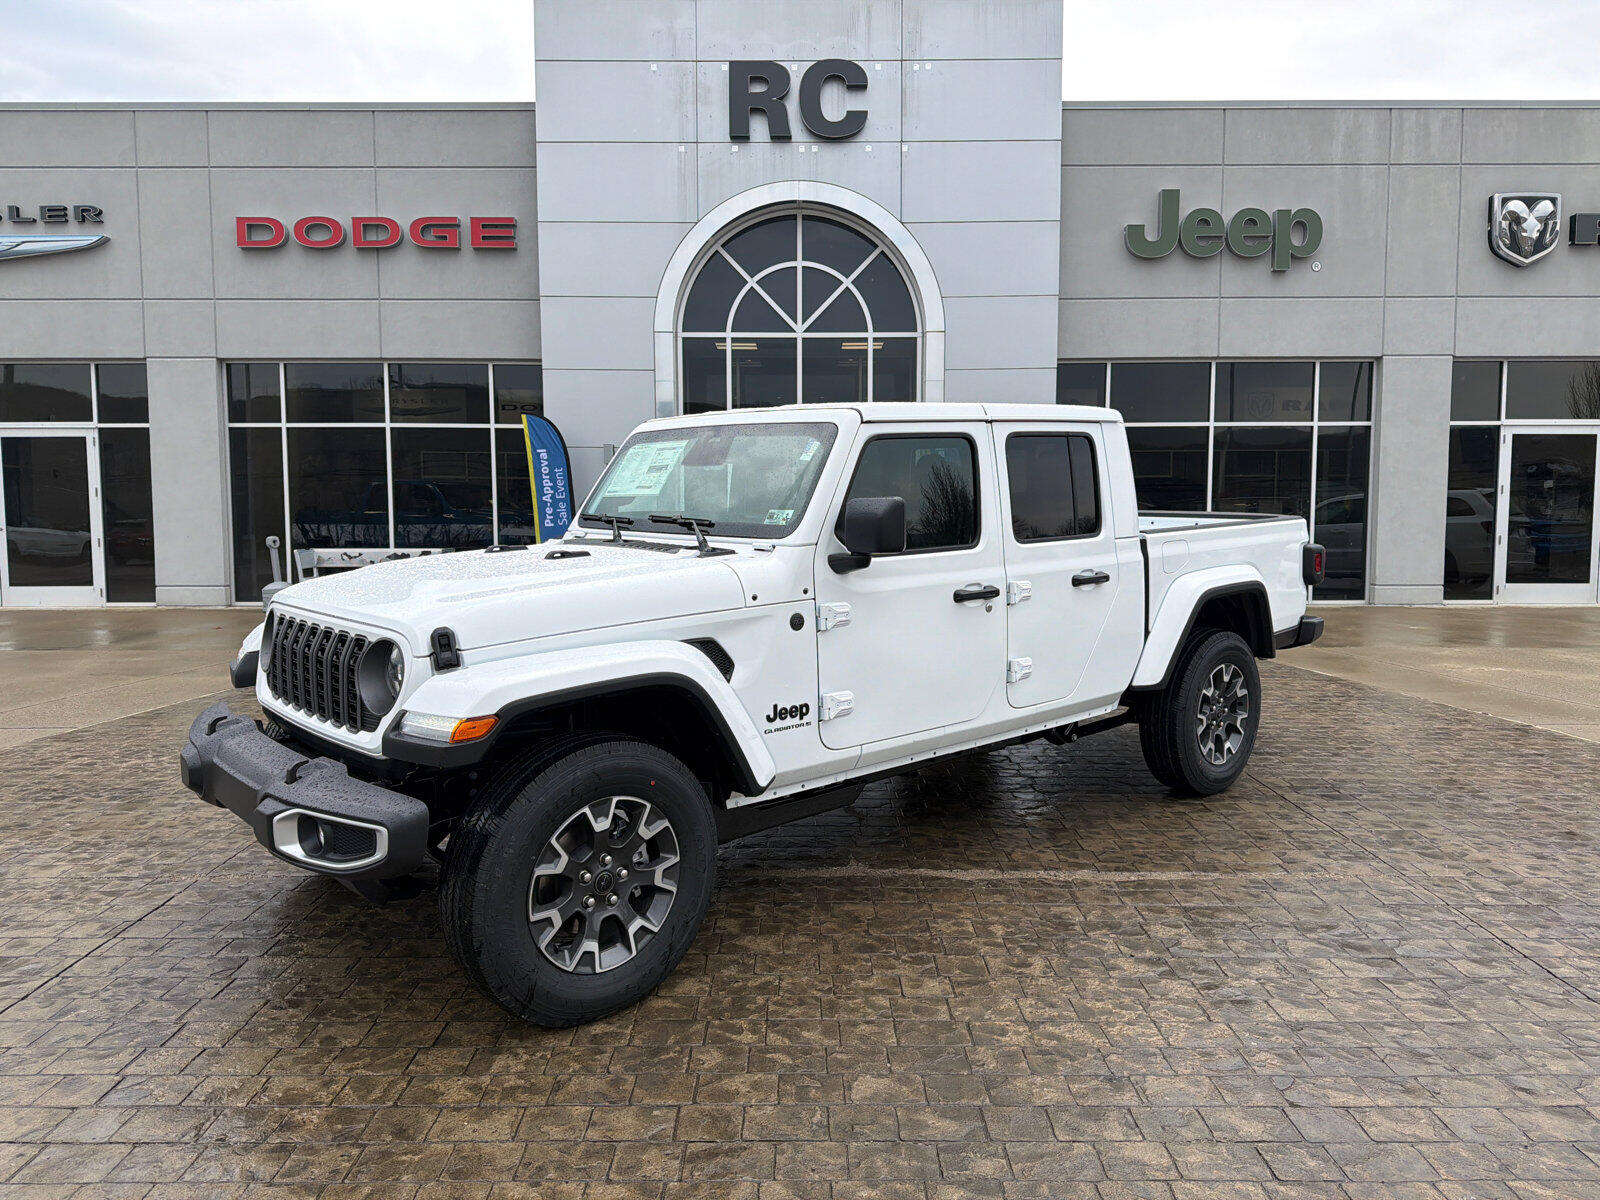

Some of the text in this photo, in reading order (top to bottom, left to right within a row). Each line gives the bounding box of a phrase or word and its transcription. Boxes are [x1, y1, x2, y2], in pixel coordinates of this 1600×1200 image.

[729, 58, 869, 141] RC
[0, 204, 104, 224] LER
[236, 215, 517, 252] DODGE
[1124, 188, 1324, 272] Jeep
[536, 448, 555, 527] Pre-Approval
[553, 467, 568, 526] Sale Event
[764, 722, 805, 735] GLADIATOR
[765, 702, 810, 723] Jeep
